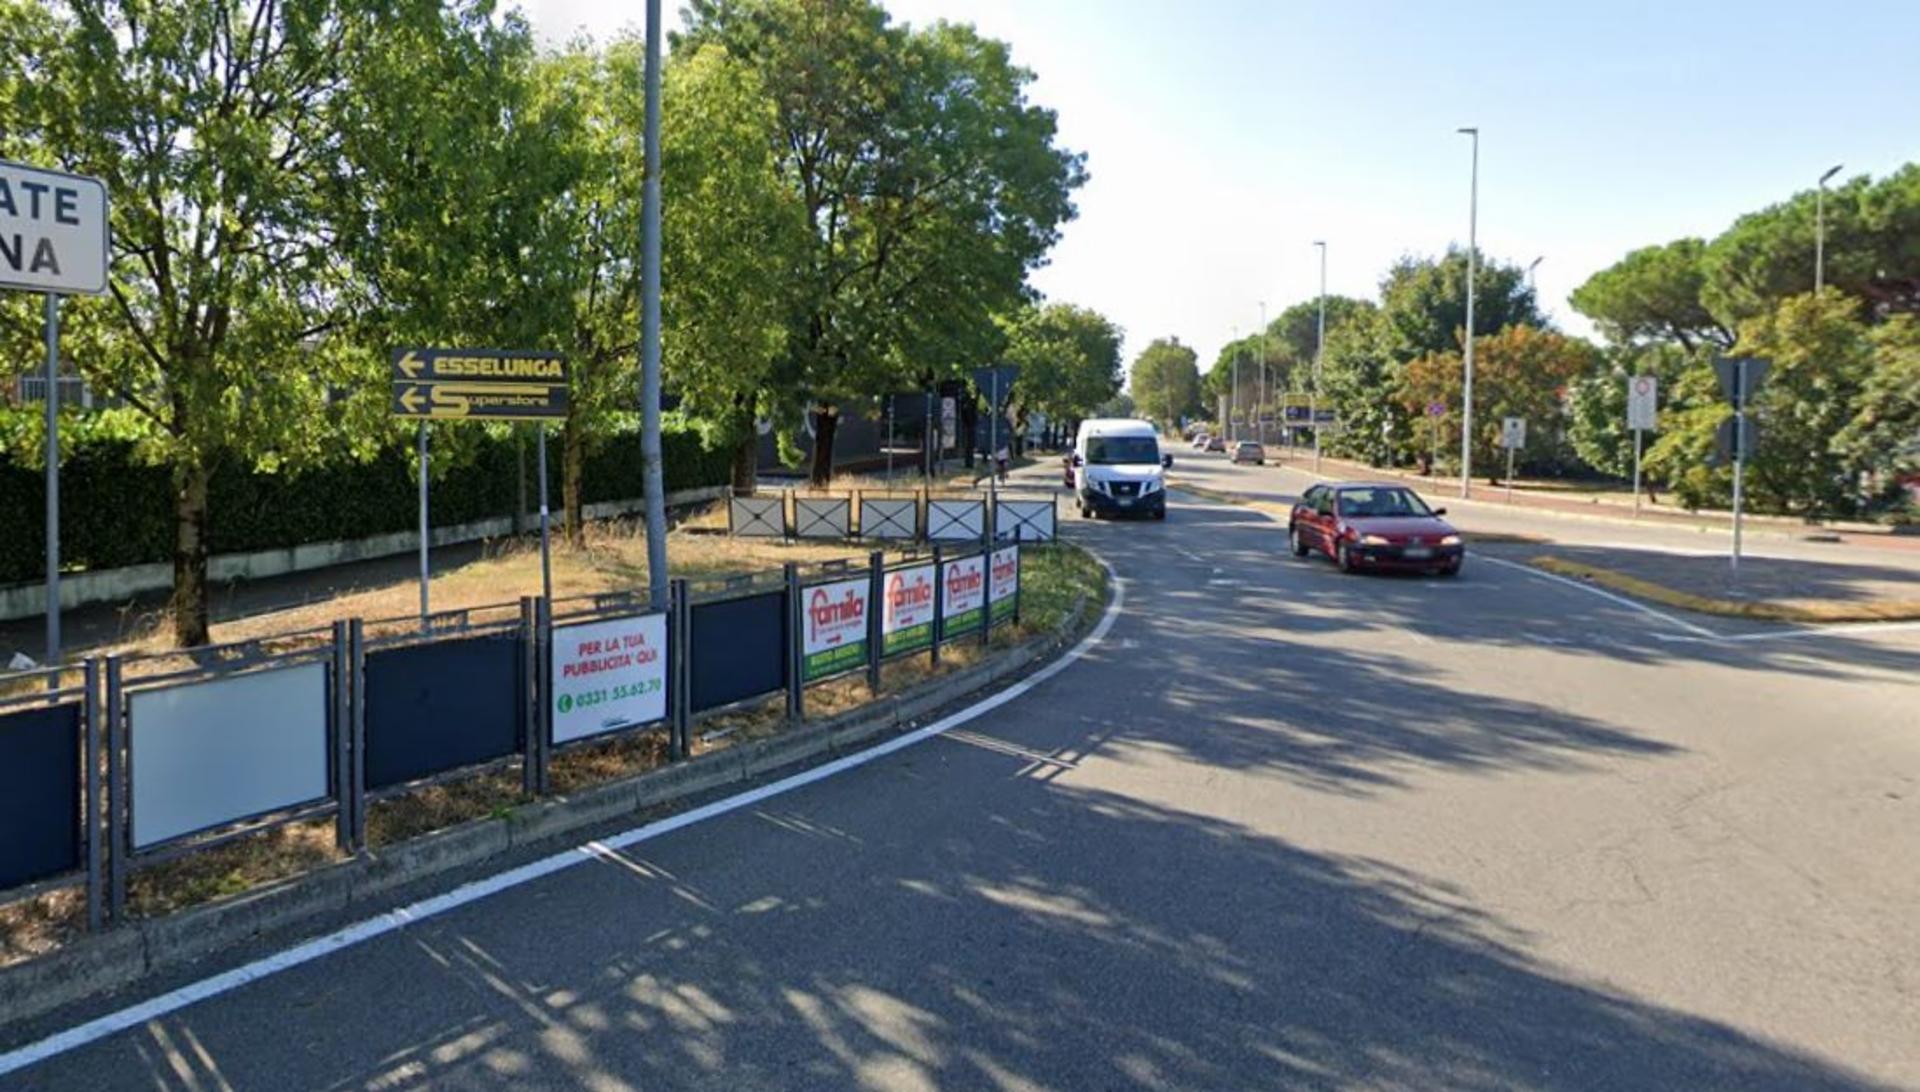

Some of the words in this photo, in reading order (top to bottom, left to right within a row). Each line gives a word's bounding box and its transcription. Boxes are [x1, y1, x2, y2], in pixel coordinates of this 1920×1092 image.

[433, 357, 563, 377] ESSELUNGA
[431, 385, 549, 416] Superstore
[888, 573, 931, 623] famila
[809, 588, 864, 642] famila
[579, 641, 601, 657] PER
[605, 638, 620, 652] LA
[624, 633, 645, 648] TUA
[637, 649, 658, 664] QUI
[576, 690, 607, 707] 0331
[613, 678, 661, 700] 55.62.70
